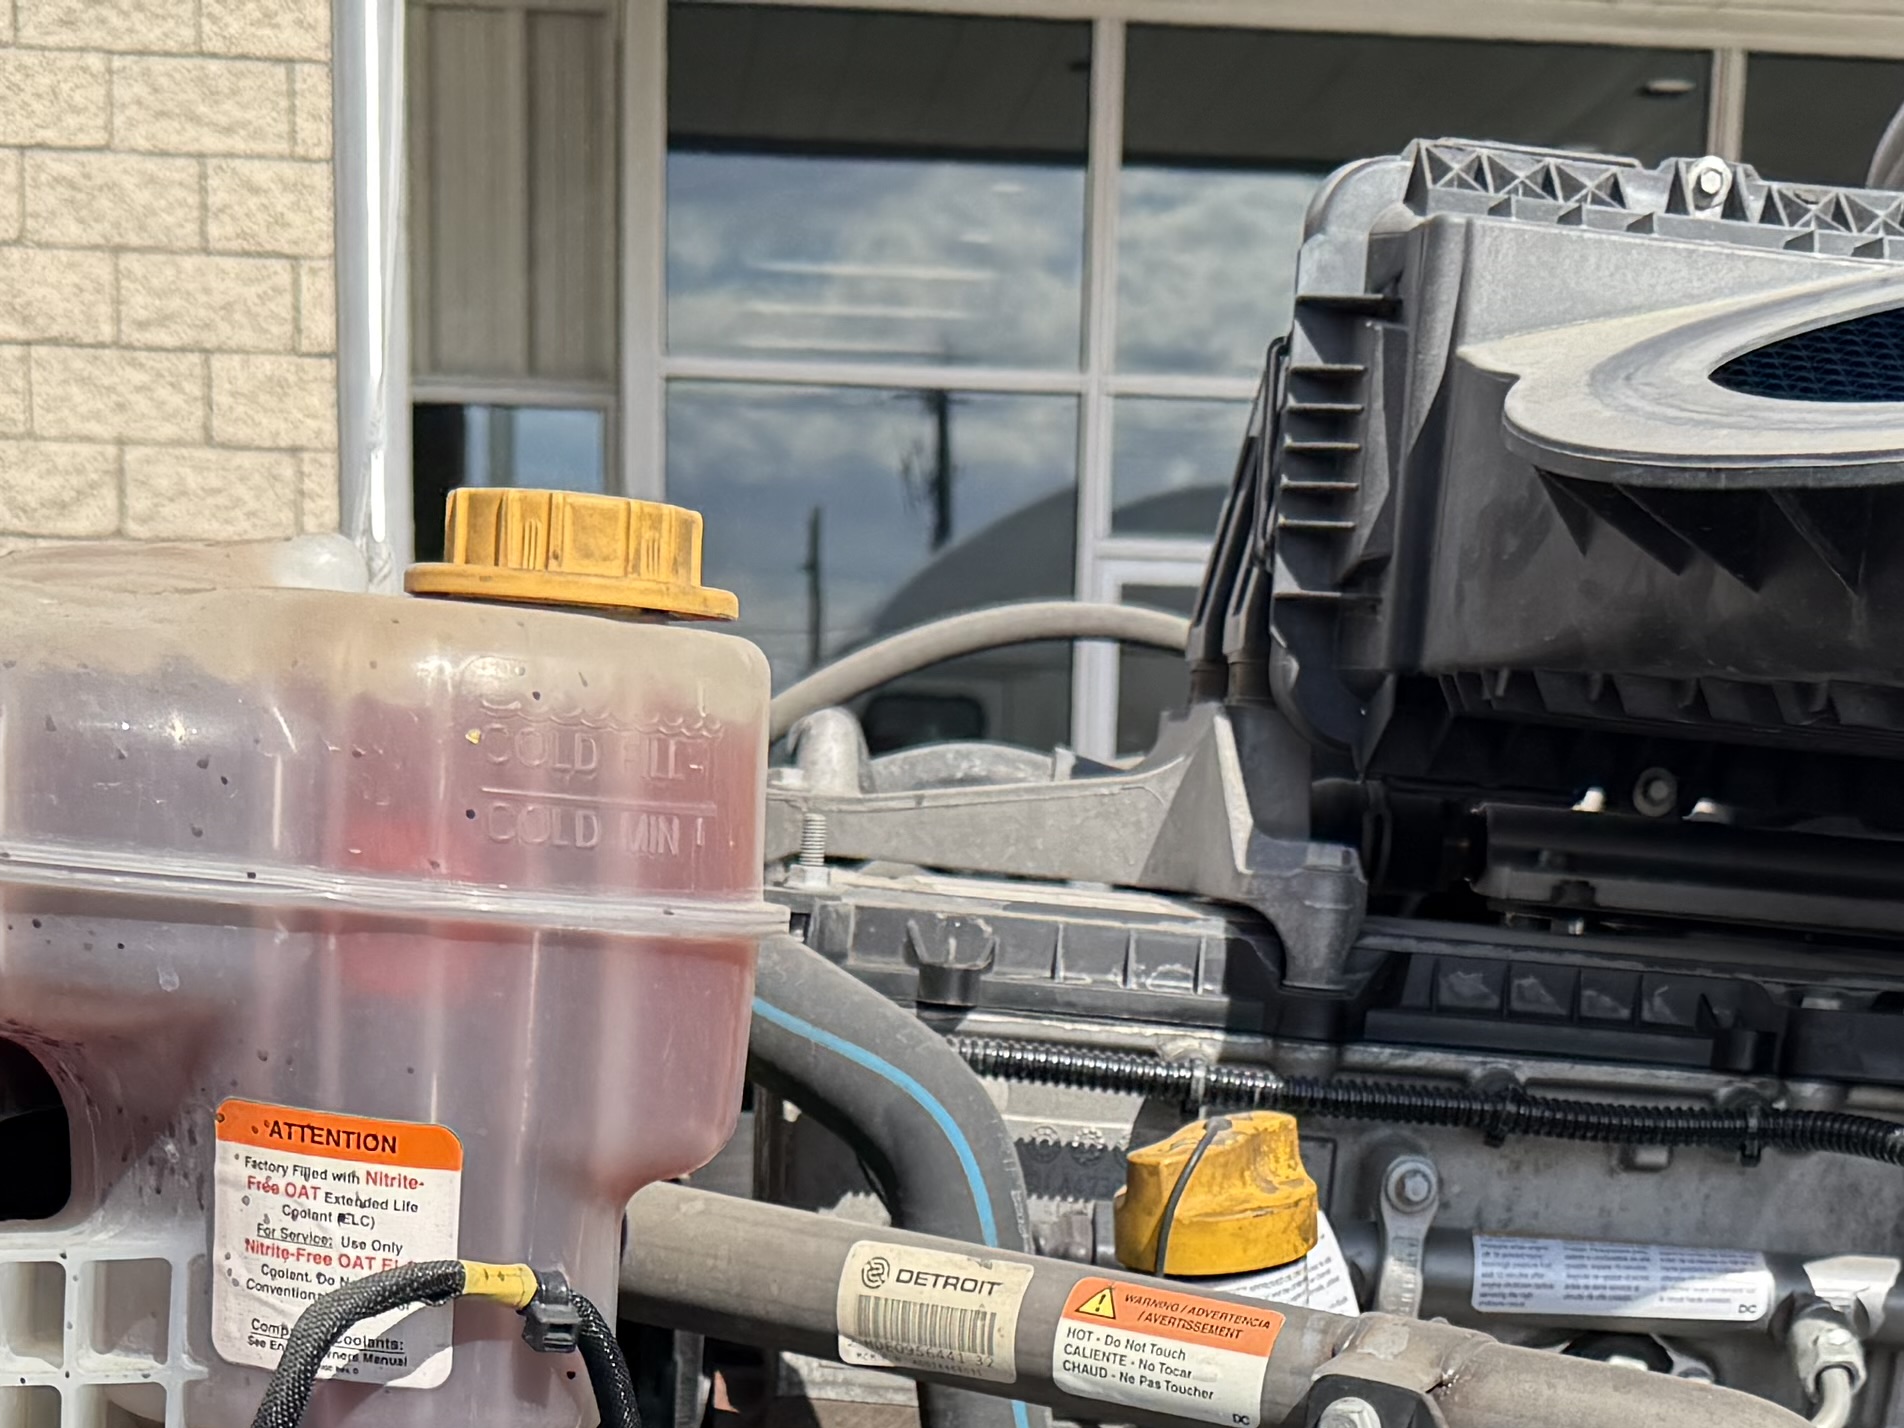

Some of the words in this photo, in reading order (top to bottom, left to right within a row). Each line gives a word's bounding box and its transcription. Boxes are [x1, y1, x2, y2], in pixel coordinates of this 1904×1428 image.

[482, 724, 597, 775] COLD
[488, 803, 599, 848] COLD
[270, 1120, 397, 1154] ATTENTION
[244, 1157, 289, 1178] Factory
[292, 1165, 328, 1182] Filled
[332, 1170, 360, 1185] with
[365, 1171, 424, 1190] Nitrite-
[248, 1176, 280, 1195] Free
[284, 1182, 320, 1201] OAT
[325, 1192, 388, 1210] Extended
[394, 1197, 418, 1212] Life
[283, 1206, 333, 1223] Coolant
[337, 1212, 375, 1229] (ELC)
[245, 1239, 332, 1268] Nitrite-Free
[338, 1254, 376, 1271] OAT
[381, 1257, 415, 1271] EL
[258, 1223, 284, 1239] For
[289, 1228, 333, 1248] Service:
[341, 1237, 366, 1250] Use
[371, 1240, 403, 1256] Only
[316, 1272, 335, 1286] Do
[896, 1269, 1003, 1296] DETROIT
[1125, 1294, 1179, 1312] WARNING
[1188, 1306, 1271, 1329] ADVERTENCIA
[1738, 1304, 1756, 1314] DC
[248, 1335, 266, 1348] See
[1145, 1314, 1243, 1340] AVERTISSEMENT
[362, 1354, 408, 1367] Manual
[1066, 1327, 1094, 1342] HOT
[1105, 1335, 1121, 1347] Do
[1126, 1339, 1146, 1353] Not
[1150, 1343, 1186, 1361] Touch
[1064, 1344, 1127, 1367] CALIENTE
[1138, 1358, 1155, 1372] No
[1160, 1363, 1192, 1379] Tocar
[1062, 1360, 1108, 1378] CHAUD
[1120, 1372, 1135, 1385] Ne
[1140, 1375, 1161, 1390] Pas
[1165, 1379, 1214, 1400] Toucher
[1233, 1413, 1250, 1425] DC
